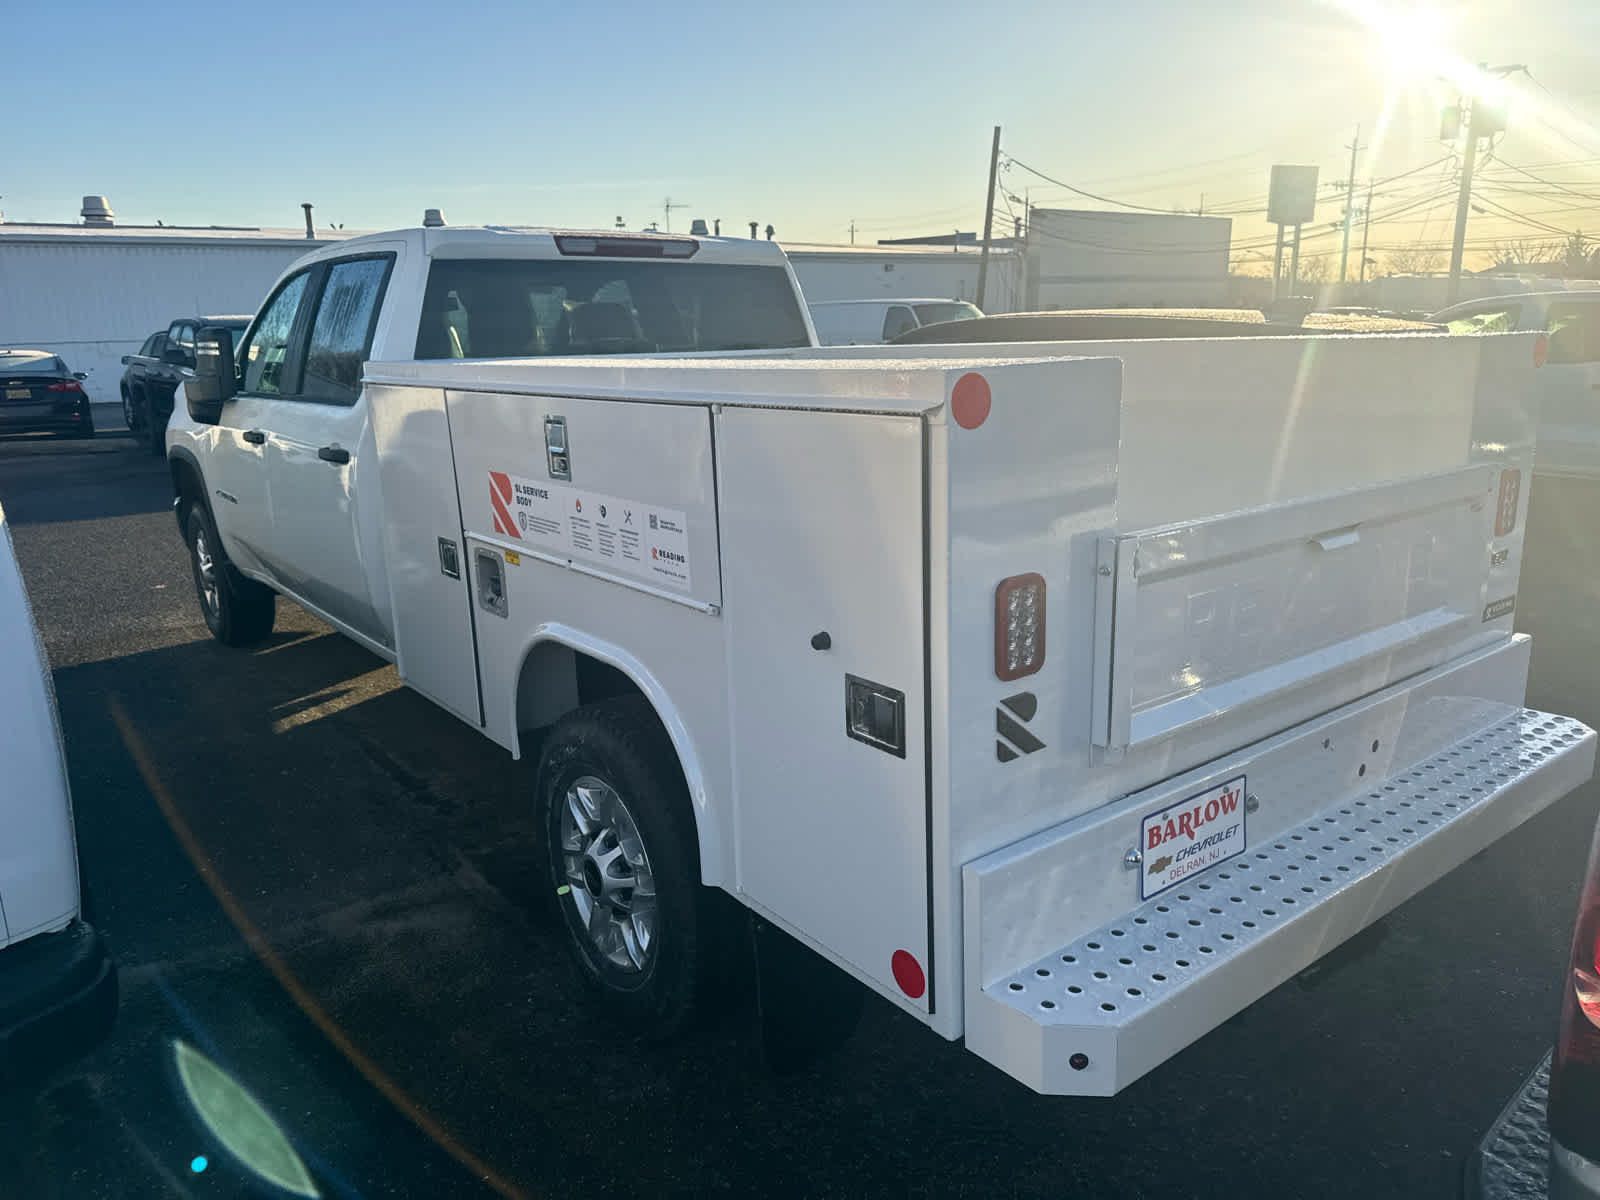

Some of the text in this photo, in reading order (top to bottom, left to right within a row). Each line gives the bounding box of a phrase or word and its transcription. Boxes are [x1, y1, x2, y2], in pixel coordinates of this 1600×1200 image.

[522, 486, 549, 500] SERVICE
[516, 495, 532, 507] BODY
[659, 549, 685, 563] READING
[1147, 789, 1241, 850] BARLOW
[1175, 824, 1240, 862] CHEVROLET
[1209, 848, 1220, 860] NJ
